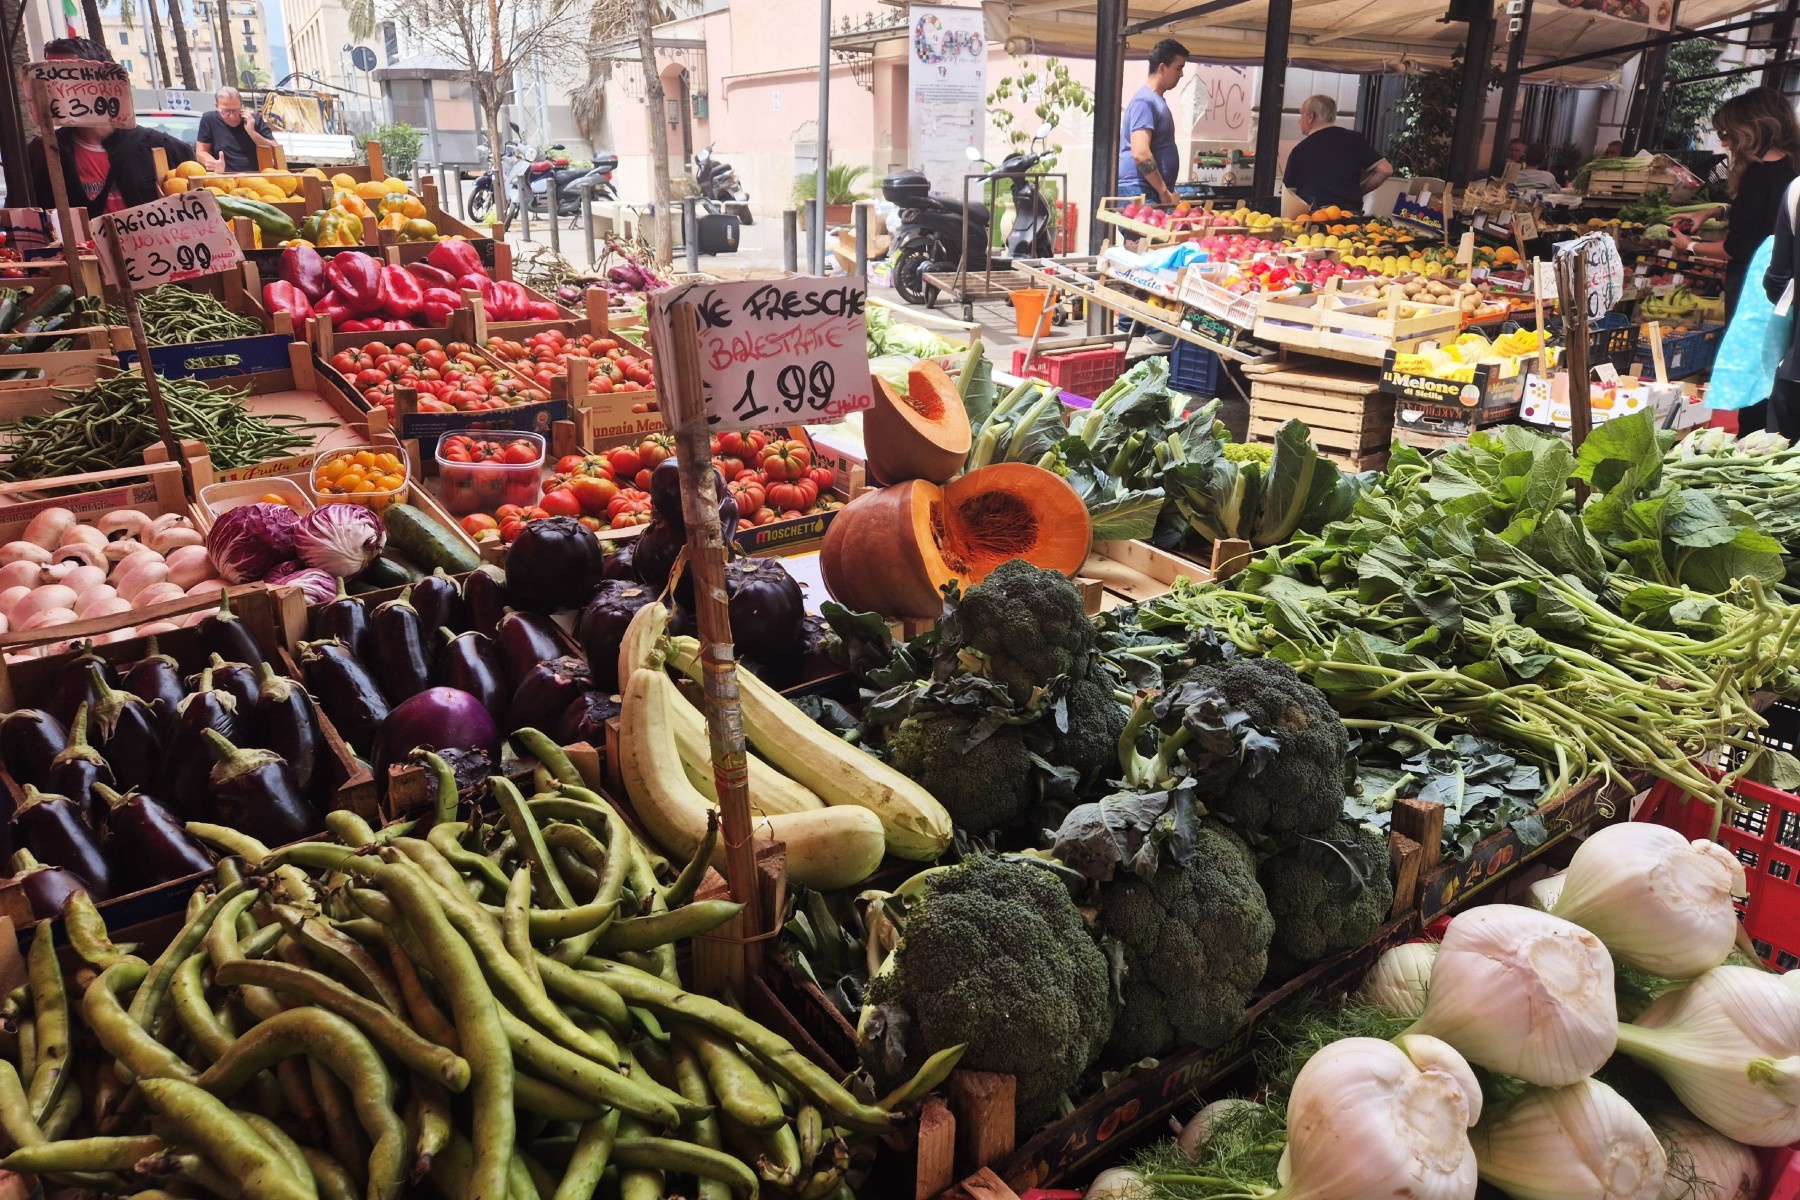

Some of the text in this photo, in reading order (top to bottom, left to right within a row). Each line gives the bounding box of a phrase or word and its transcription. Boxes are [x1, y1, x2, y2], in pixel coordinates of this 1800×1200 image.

[50, 99, 66, 118] €
[147, 242, 212, 276] 3.99
[742, 284, 865, 321] FRESCHE
[1392, 372, 1460, 396] Melone
[1415, 390, 1444, 401] Sicilia
[68, 500, 107, 514] ANGIARE
